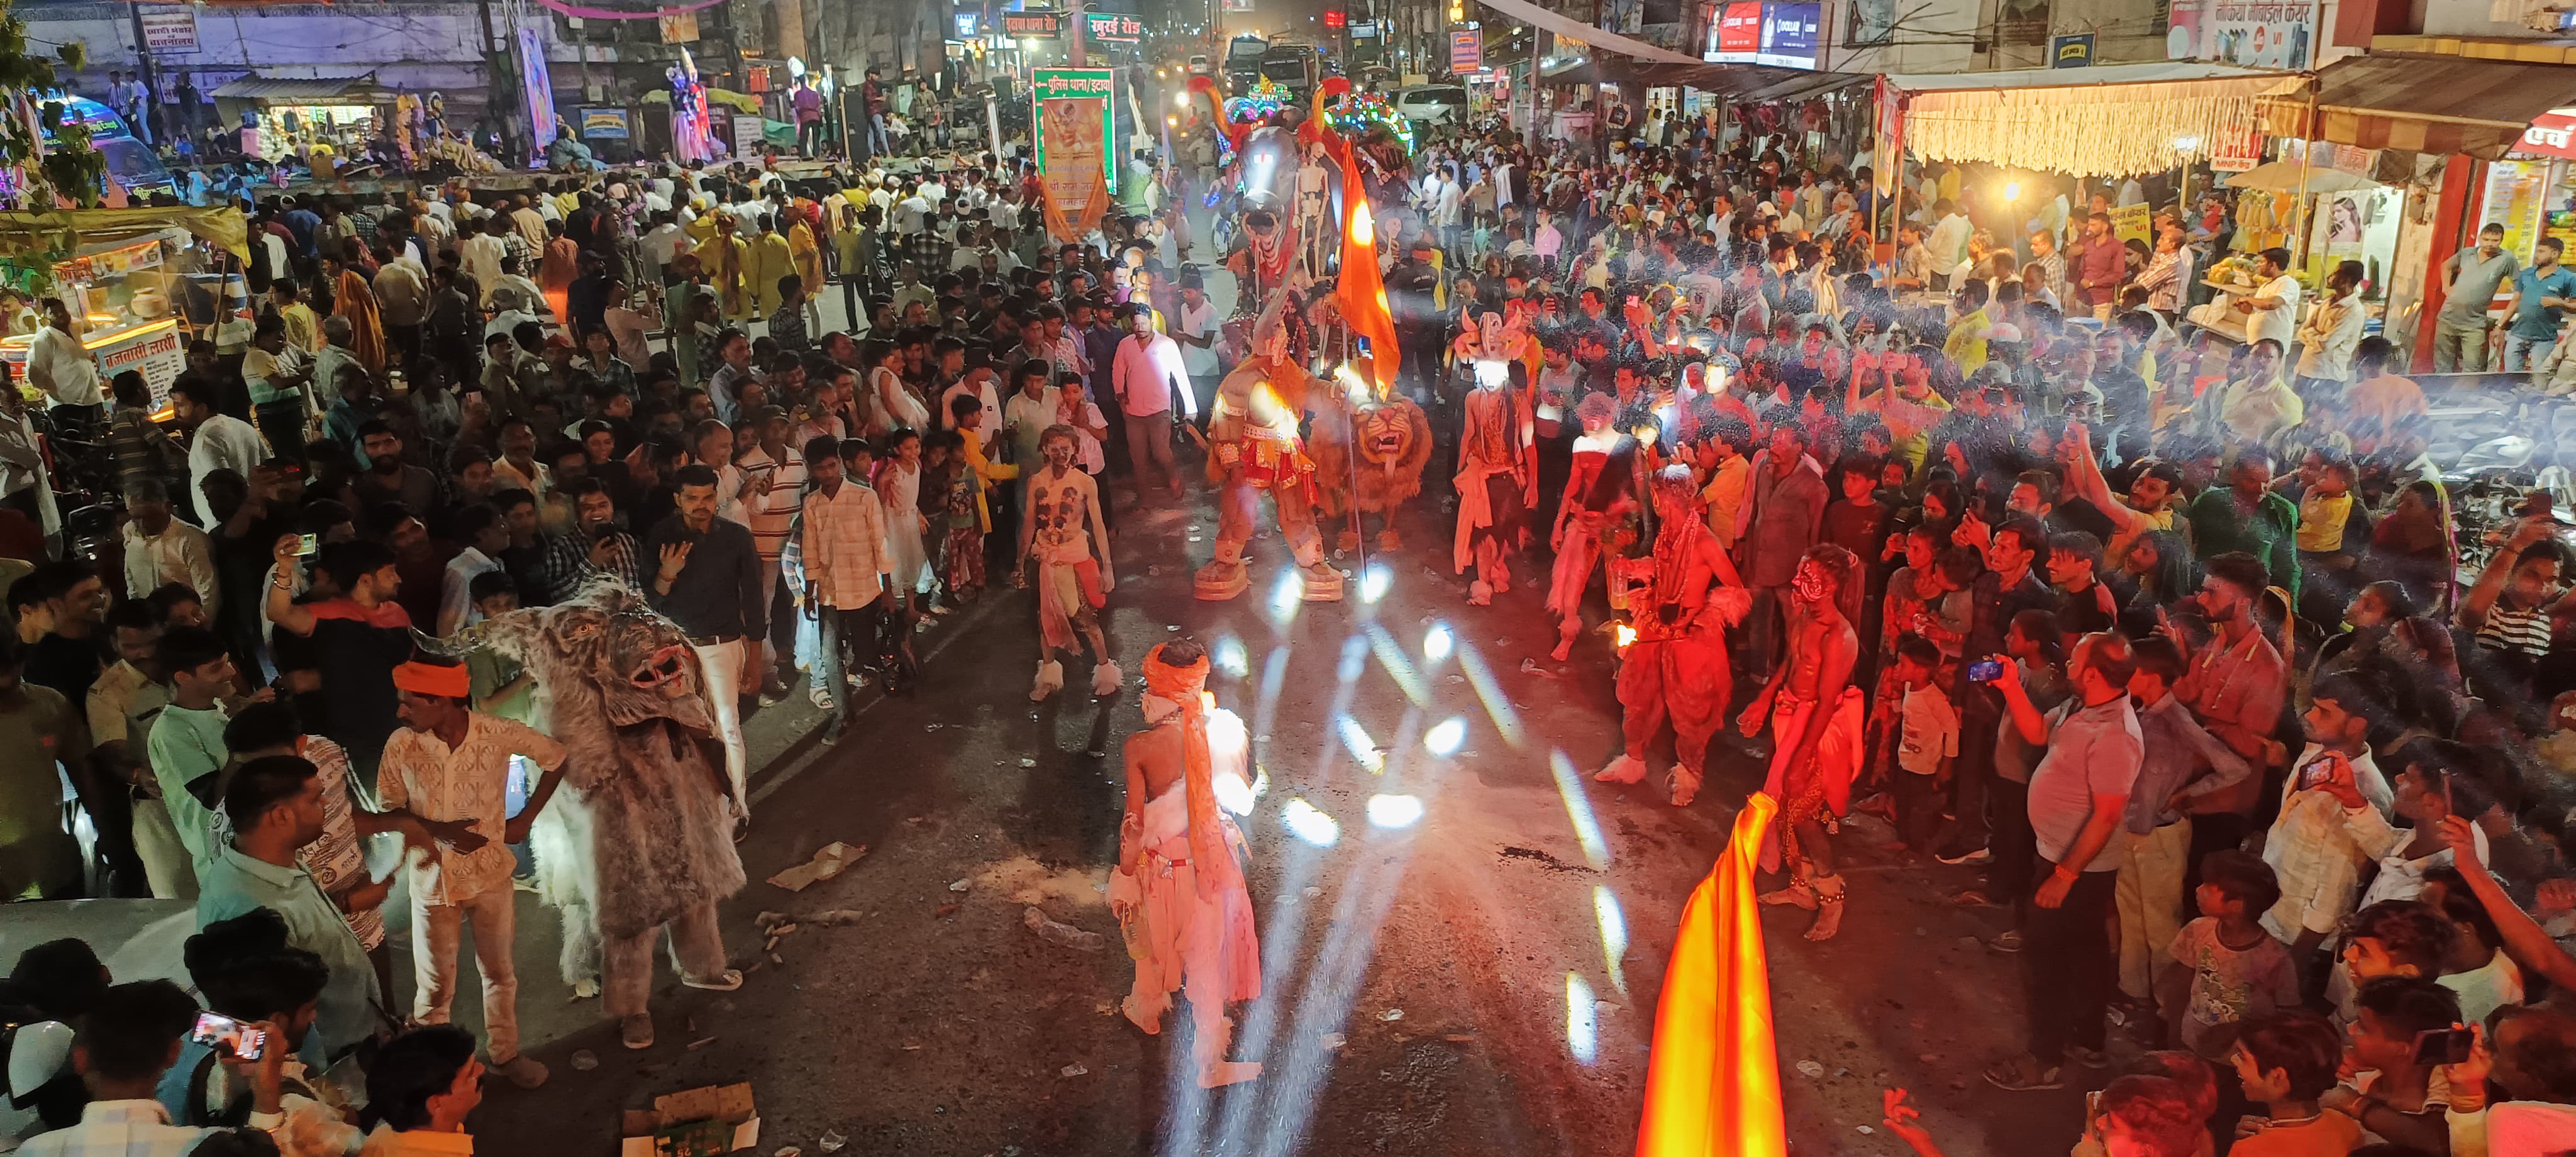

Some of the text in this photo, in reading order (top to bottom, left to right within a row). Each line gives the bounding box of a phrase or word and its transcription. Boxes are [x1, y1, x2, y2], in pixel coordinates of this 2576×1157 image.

[1026, 18, 1043, 30] थाना
[1045, 14, 1057, 31] रोड
[1091, 17, 1141, 36] खुरई रोड
[1048, 75, 1069, 94] पुलिस
[2525, 125, 2574, 149] एवं
[1063, 182, 1077, 191] राम
[148, 333, 177, 355] लस्सी
